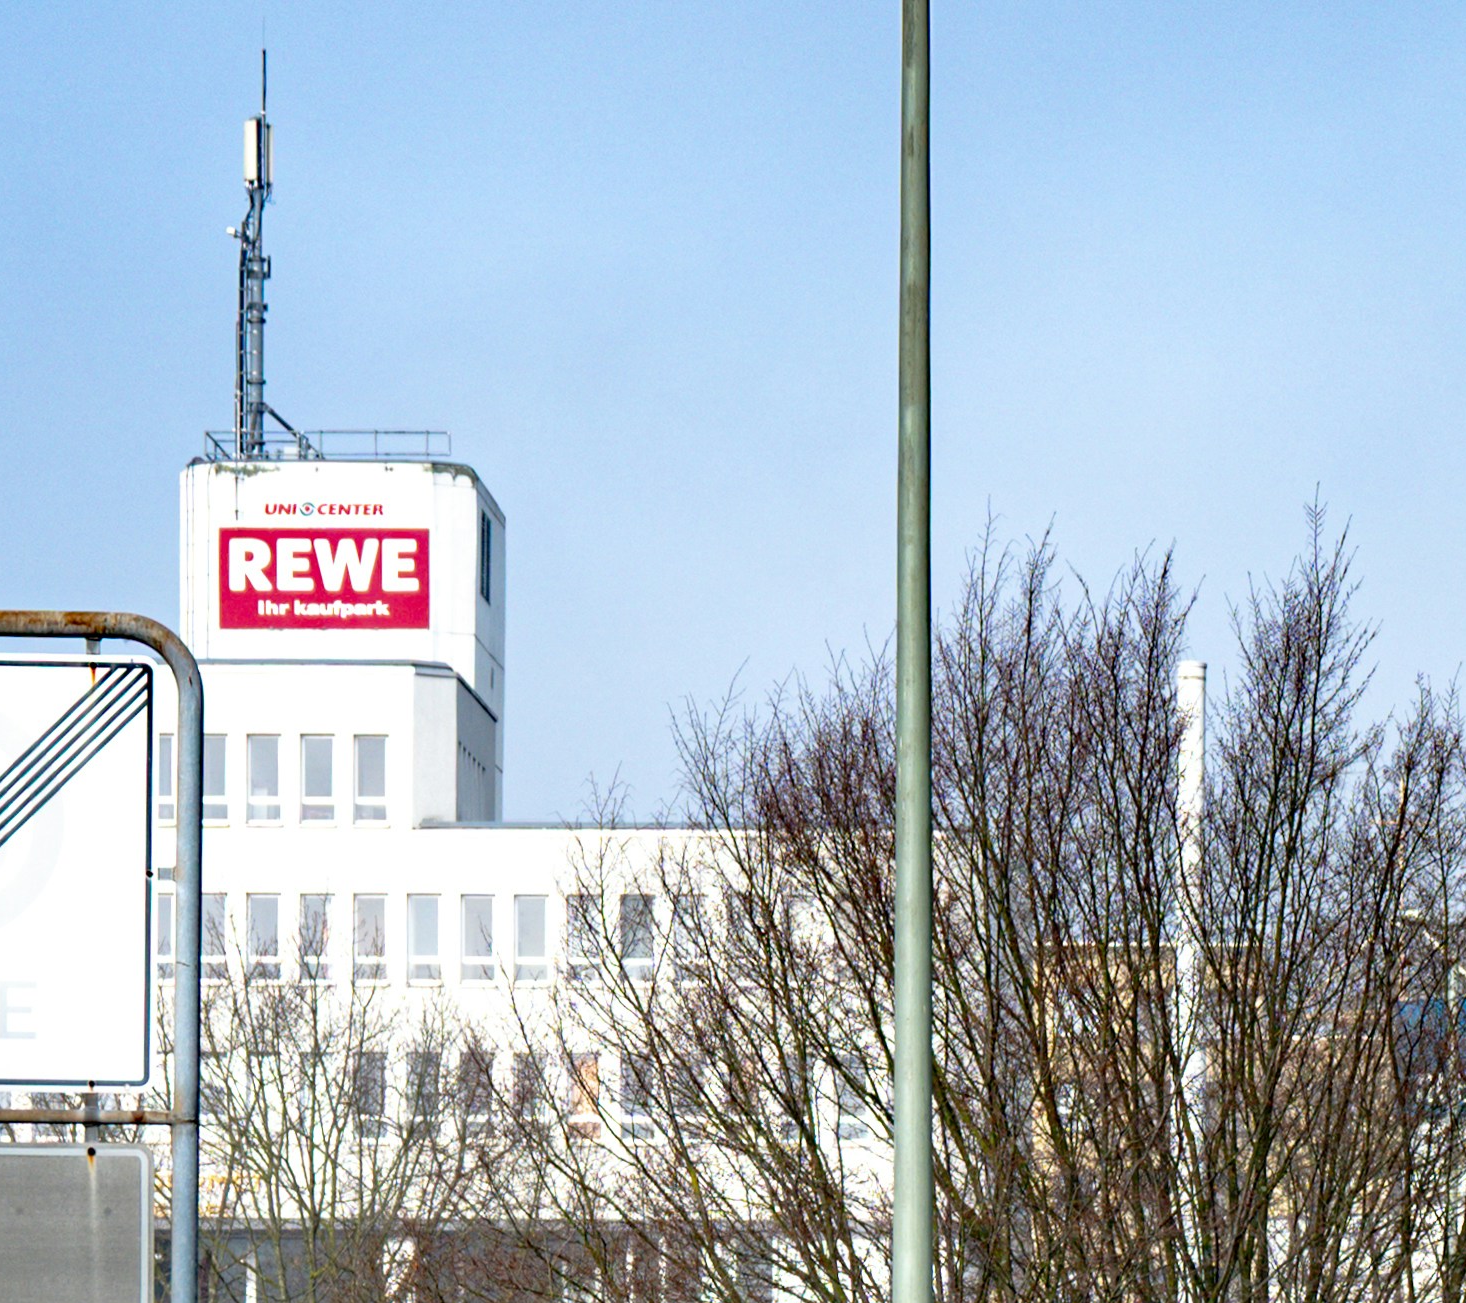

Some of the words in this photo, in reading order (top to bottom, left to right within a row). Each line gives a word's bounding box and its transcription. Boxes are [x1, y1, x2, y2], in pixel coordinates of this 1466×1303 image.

[264, 503, 297, 516] UNI
[316, 503, 384, 516] CENTER
[228, 537, 420, 592] REWE
[258, 600, 289, 615] Ihr
